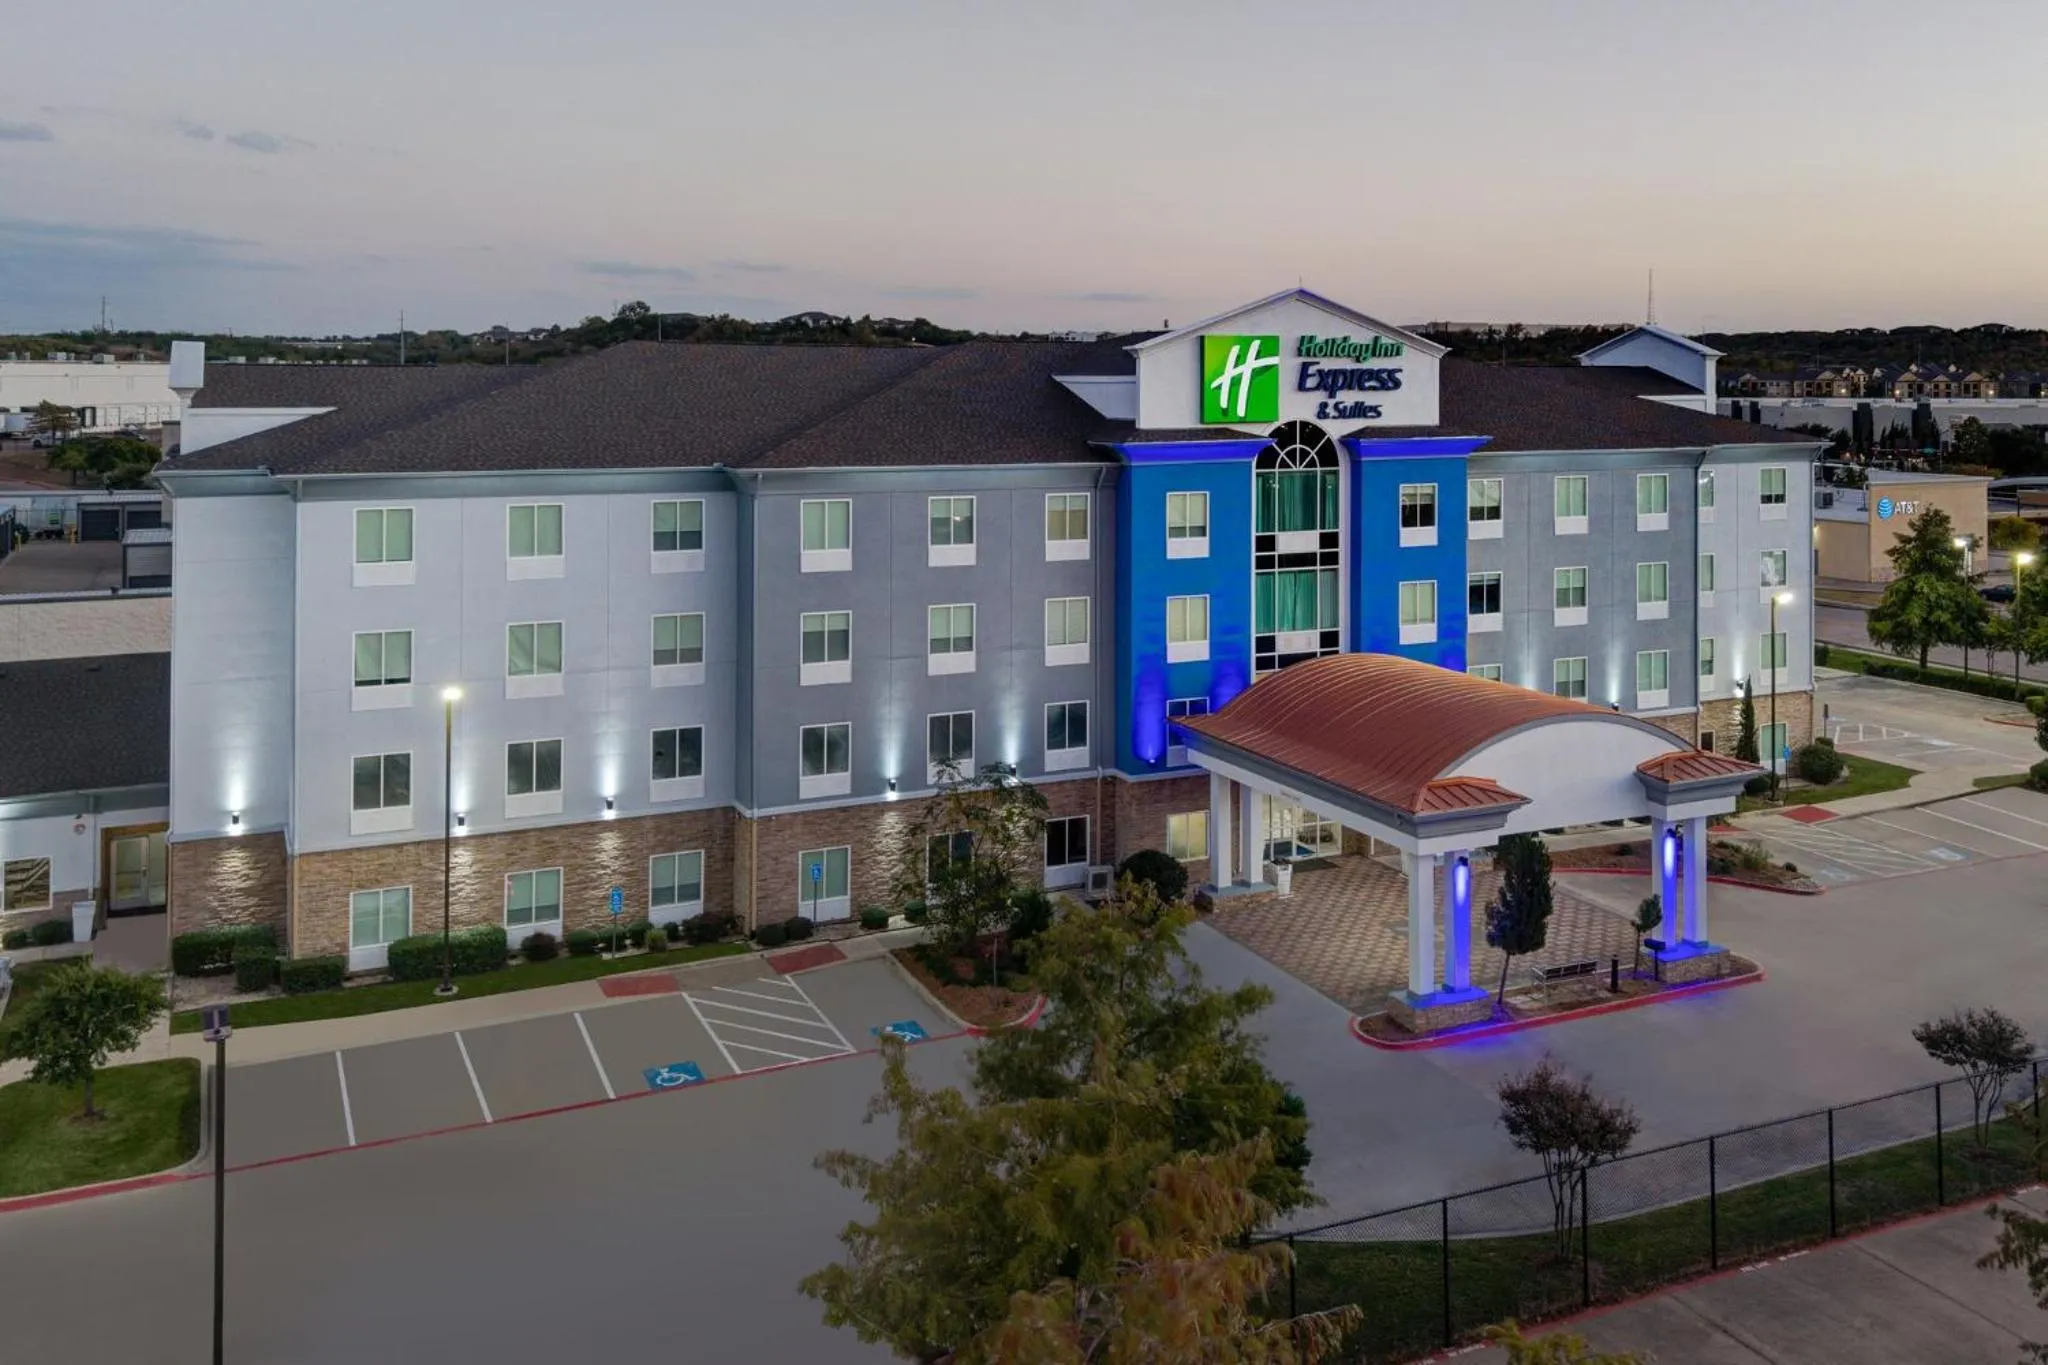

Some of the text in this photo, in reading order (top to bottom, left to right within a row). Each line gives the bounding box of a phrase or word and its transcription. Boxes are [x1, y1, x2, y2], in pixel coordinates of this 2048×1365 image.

[1297, 335, 1404, 364] Holiday Inn
[1298, 361, 1403, 399] Express
[1316, 400, 1383, 419] & Suites
[1894, 500, 1920, 514] AT&T
